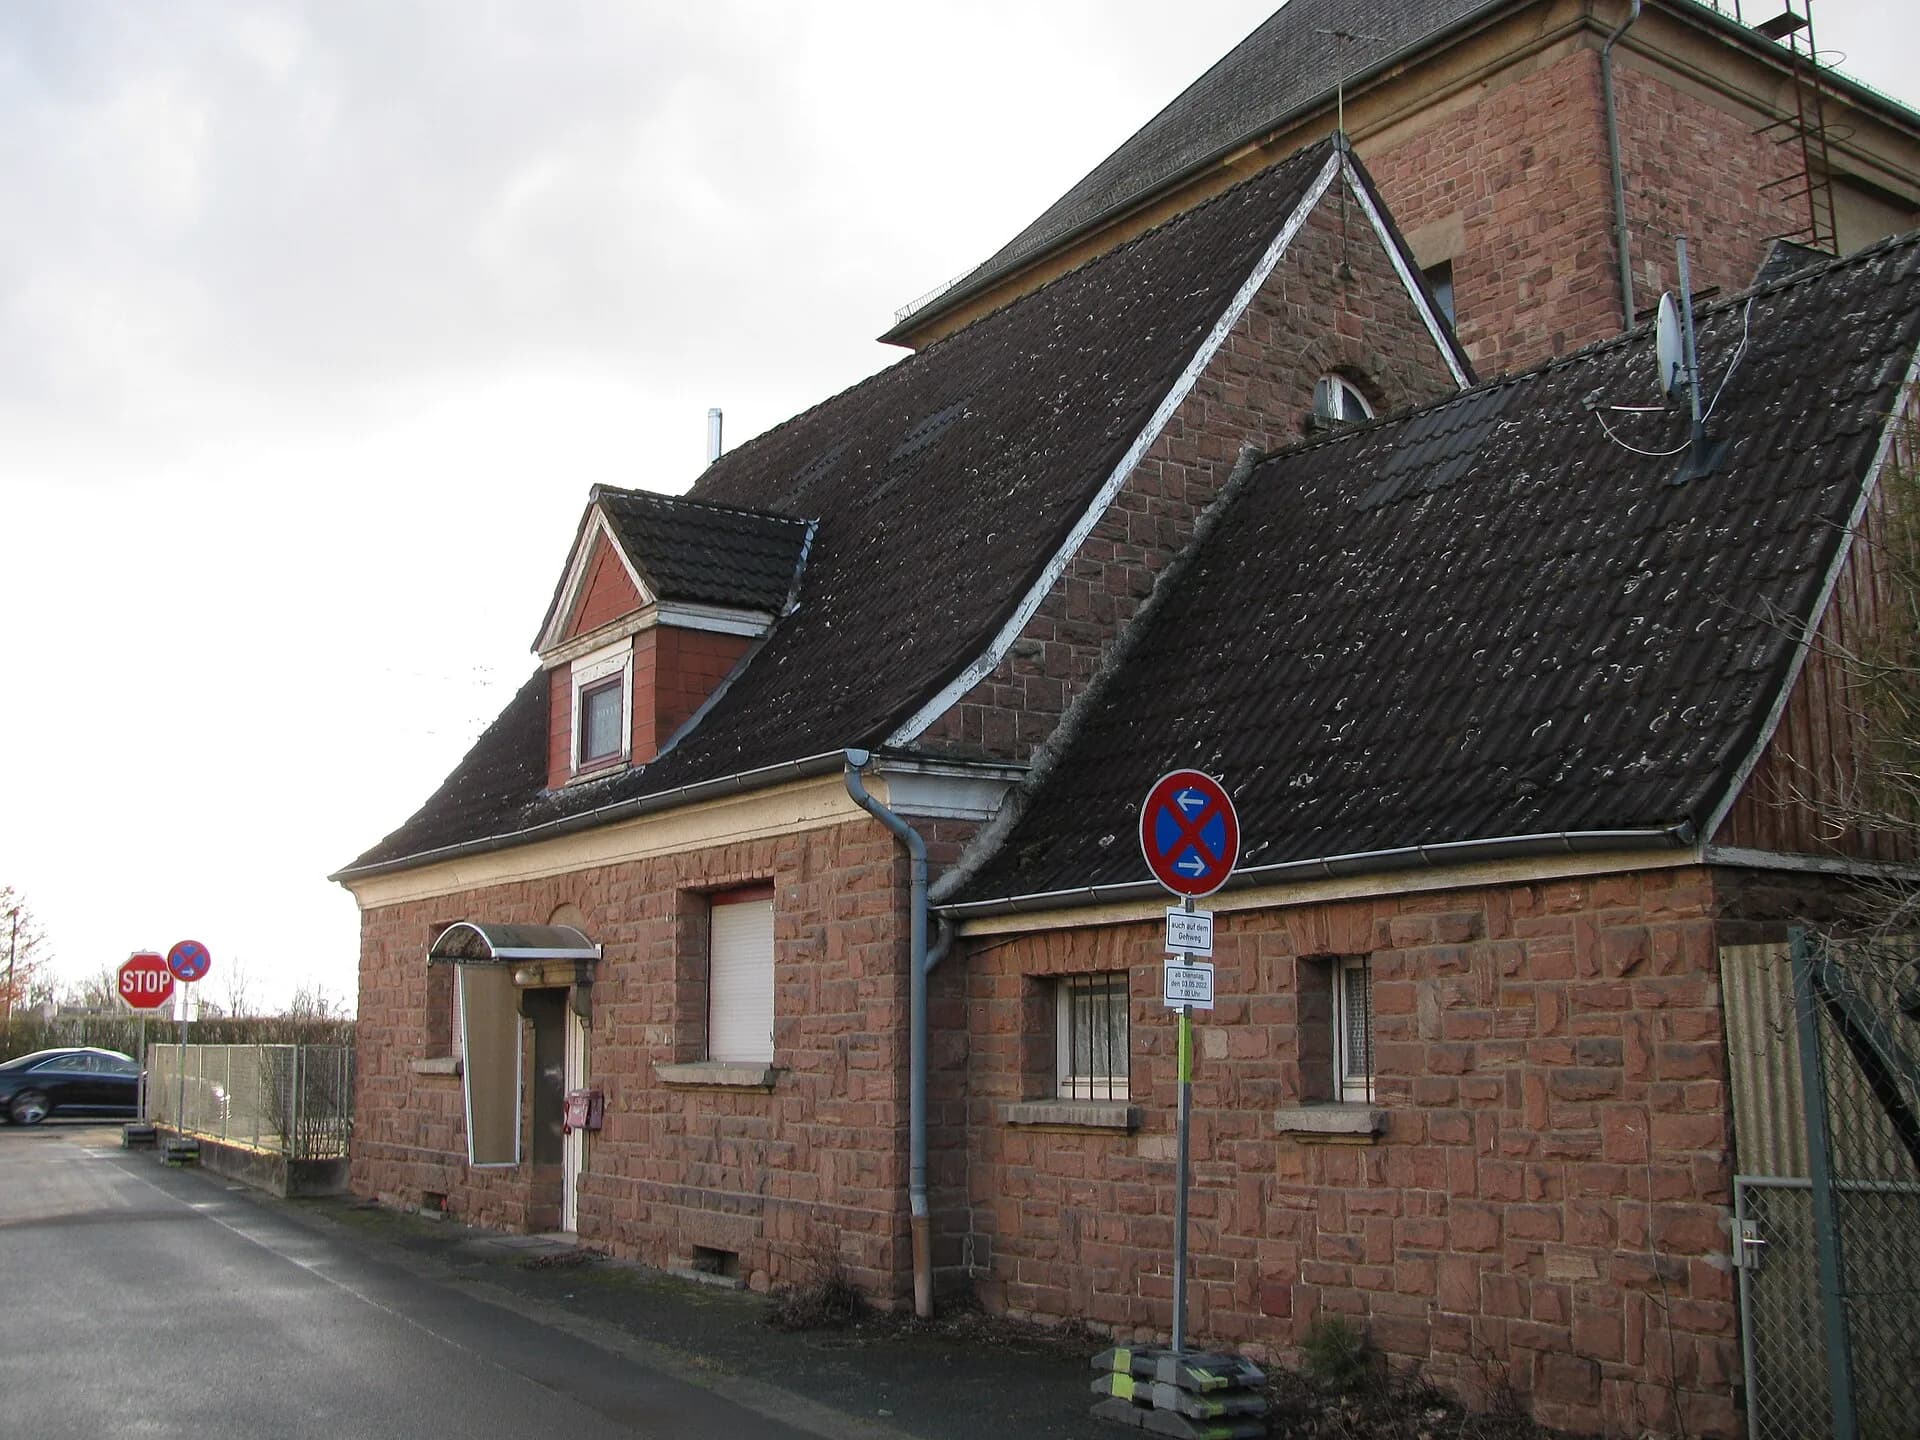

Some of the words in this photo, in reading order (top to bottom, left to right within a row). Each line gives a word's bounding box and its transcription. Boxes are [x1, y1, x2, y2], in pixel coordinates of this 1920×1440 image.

[1196, 924, 1209, 932] dem
[1178, 932, 1201, 943] Gehweg
[122, 970, 170, 993] STOP
